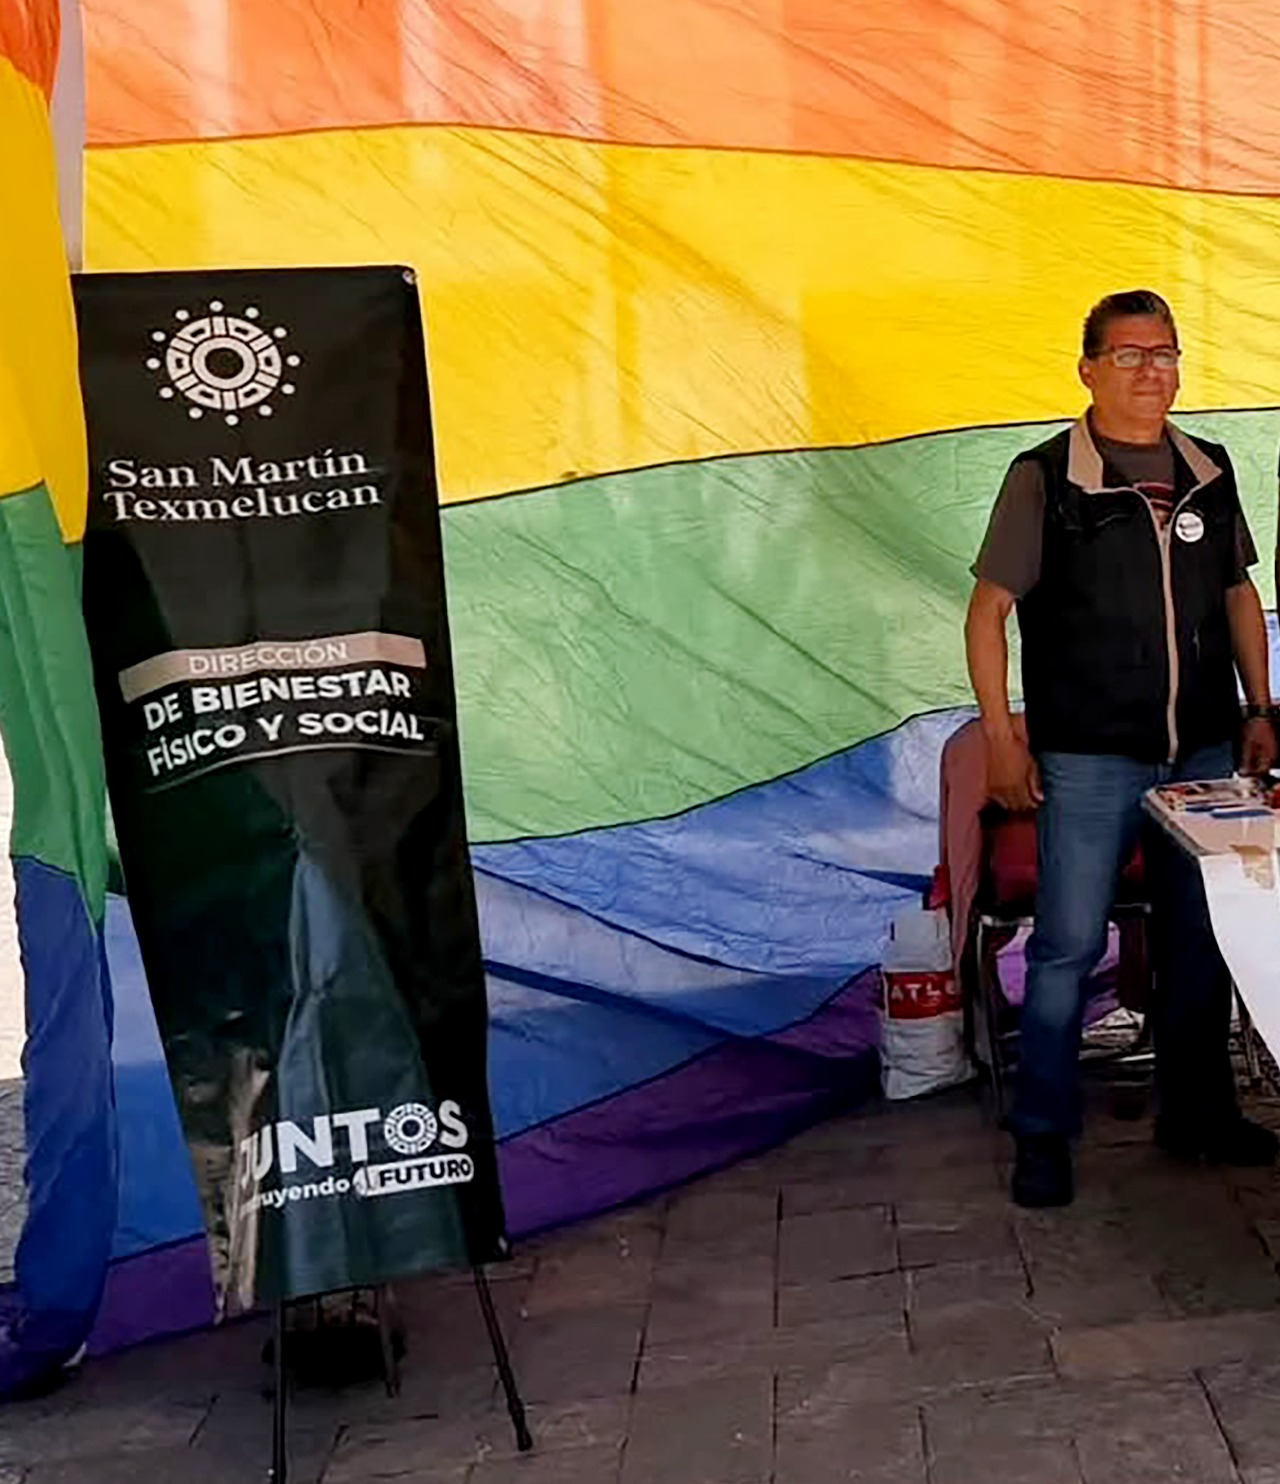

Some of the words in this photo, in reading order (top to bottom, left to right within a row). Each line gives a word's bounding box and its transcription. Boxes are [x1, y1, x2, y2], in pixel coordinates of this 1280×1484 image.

[108, 459, 200, 488] San
[208, 448, 369, 486] Martín
[102, 484, 384, 522] Texmelucan
[189, 640, 348, 674] DIRECCIÓN
[143, 693, 183, 730] DE
[191, 669, 412, 714] BIENESTAR
[147, 723, 246, 776] FÍSICO
[256, 713, 285, 741] Y
[297, 709, 424, 741] SOCIAL
[379, 1158, 472, 1188] FUTURO
